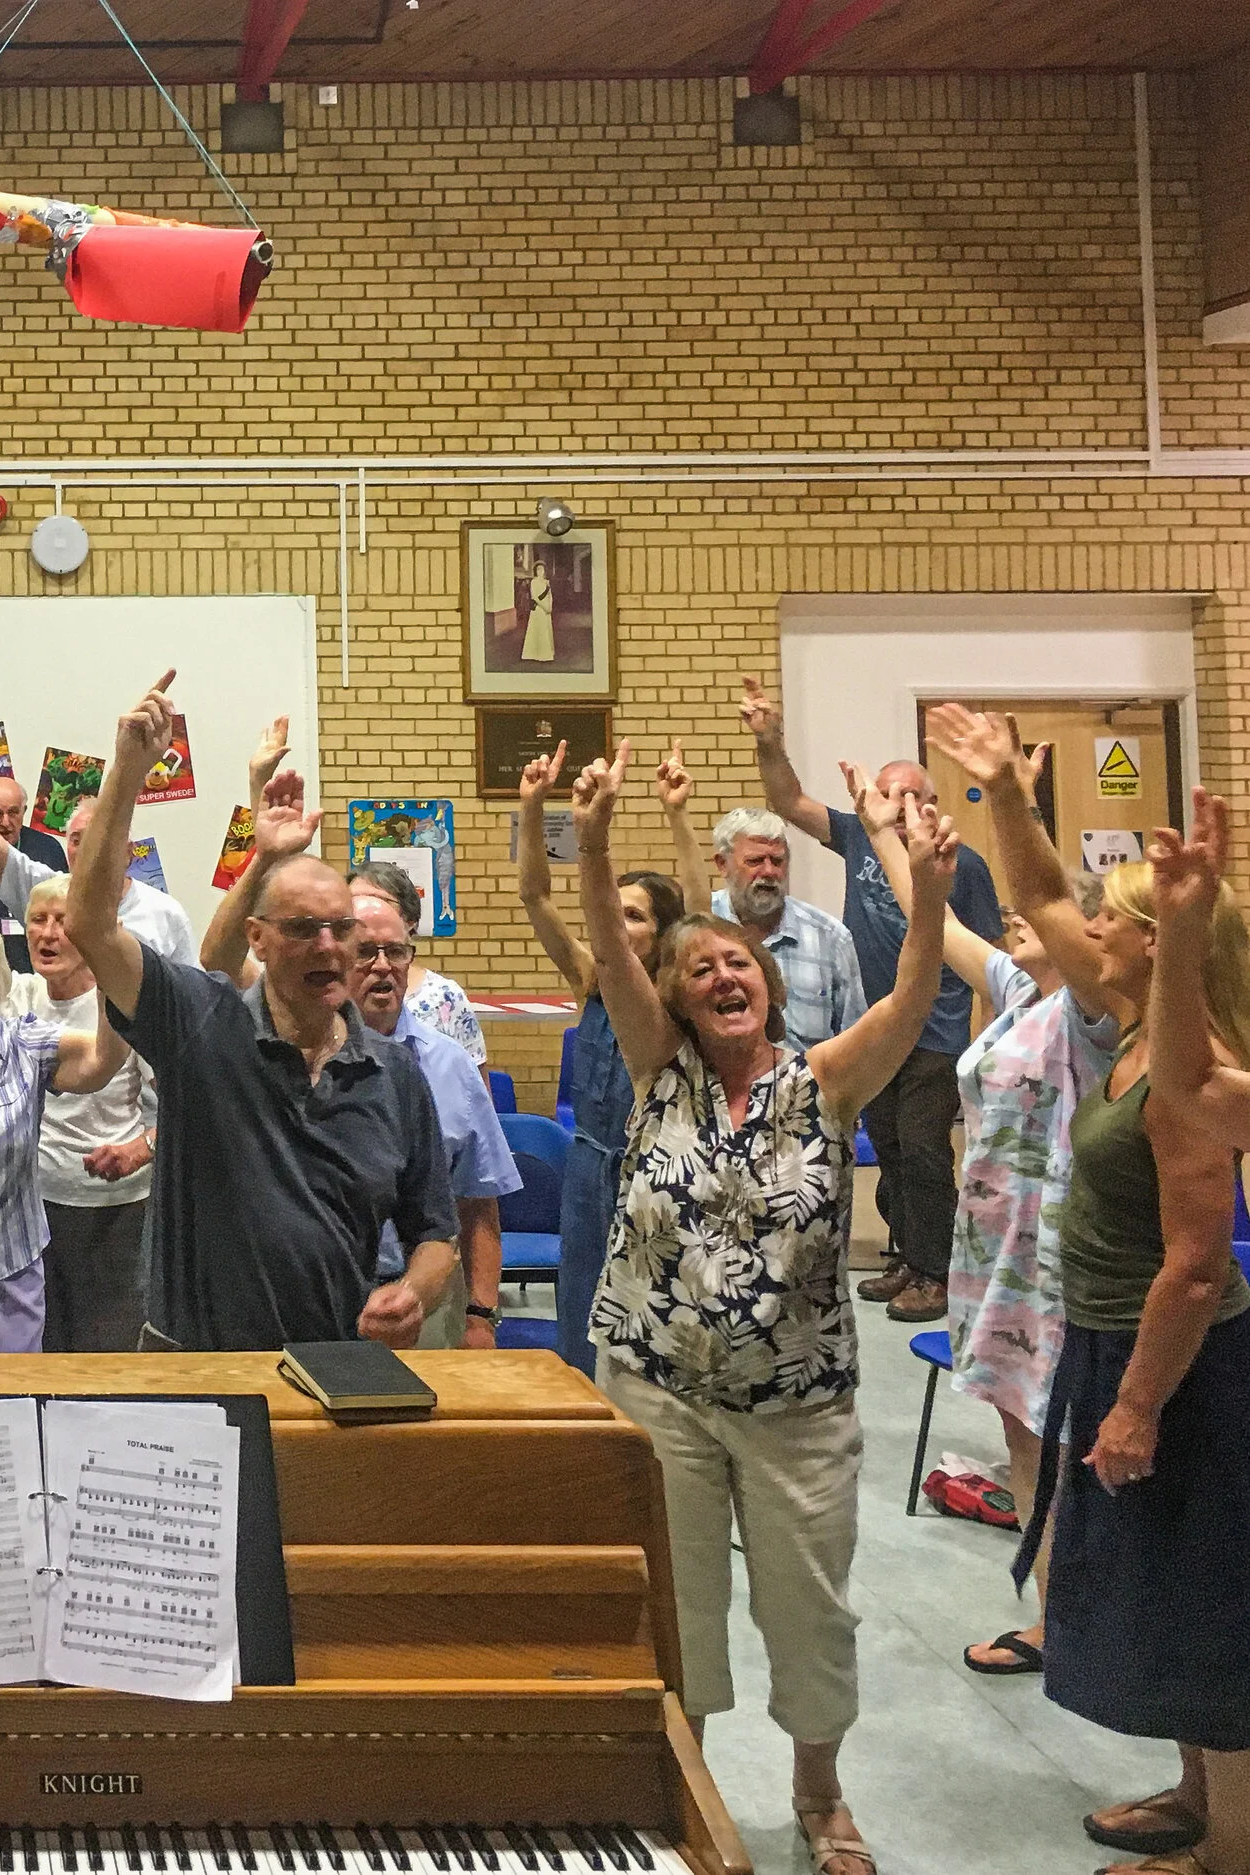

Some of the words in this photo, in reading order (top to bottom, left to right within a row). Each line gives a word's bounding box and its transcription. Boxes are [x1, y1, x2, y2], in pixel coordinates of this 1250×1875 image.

[1100, 780, 1138, 791] Danger
[139, 791, 165, 802] SUPER
[165, 788, 194, 800] SWEDE!
[127, 1439, 148, 1450] TOTAL
[150, 1443, 175, 1453] PRAISE
[44, 1774, 139, 1793] KNIGHT
